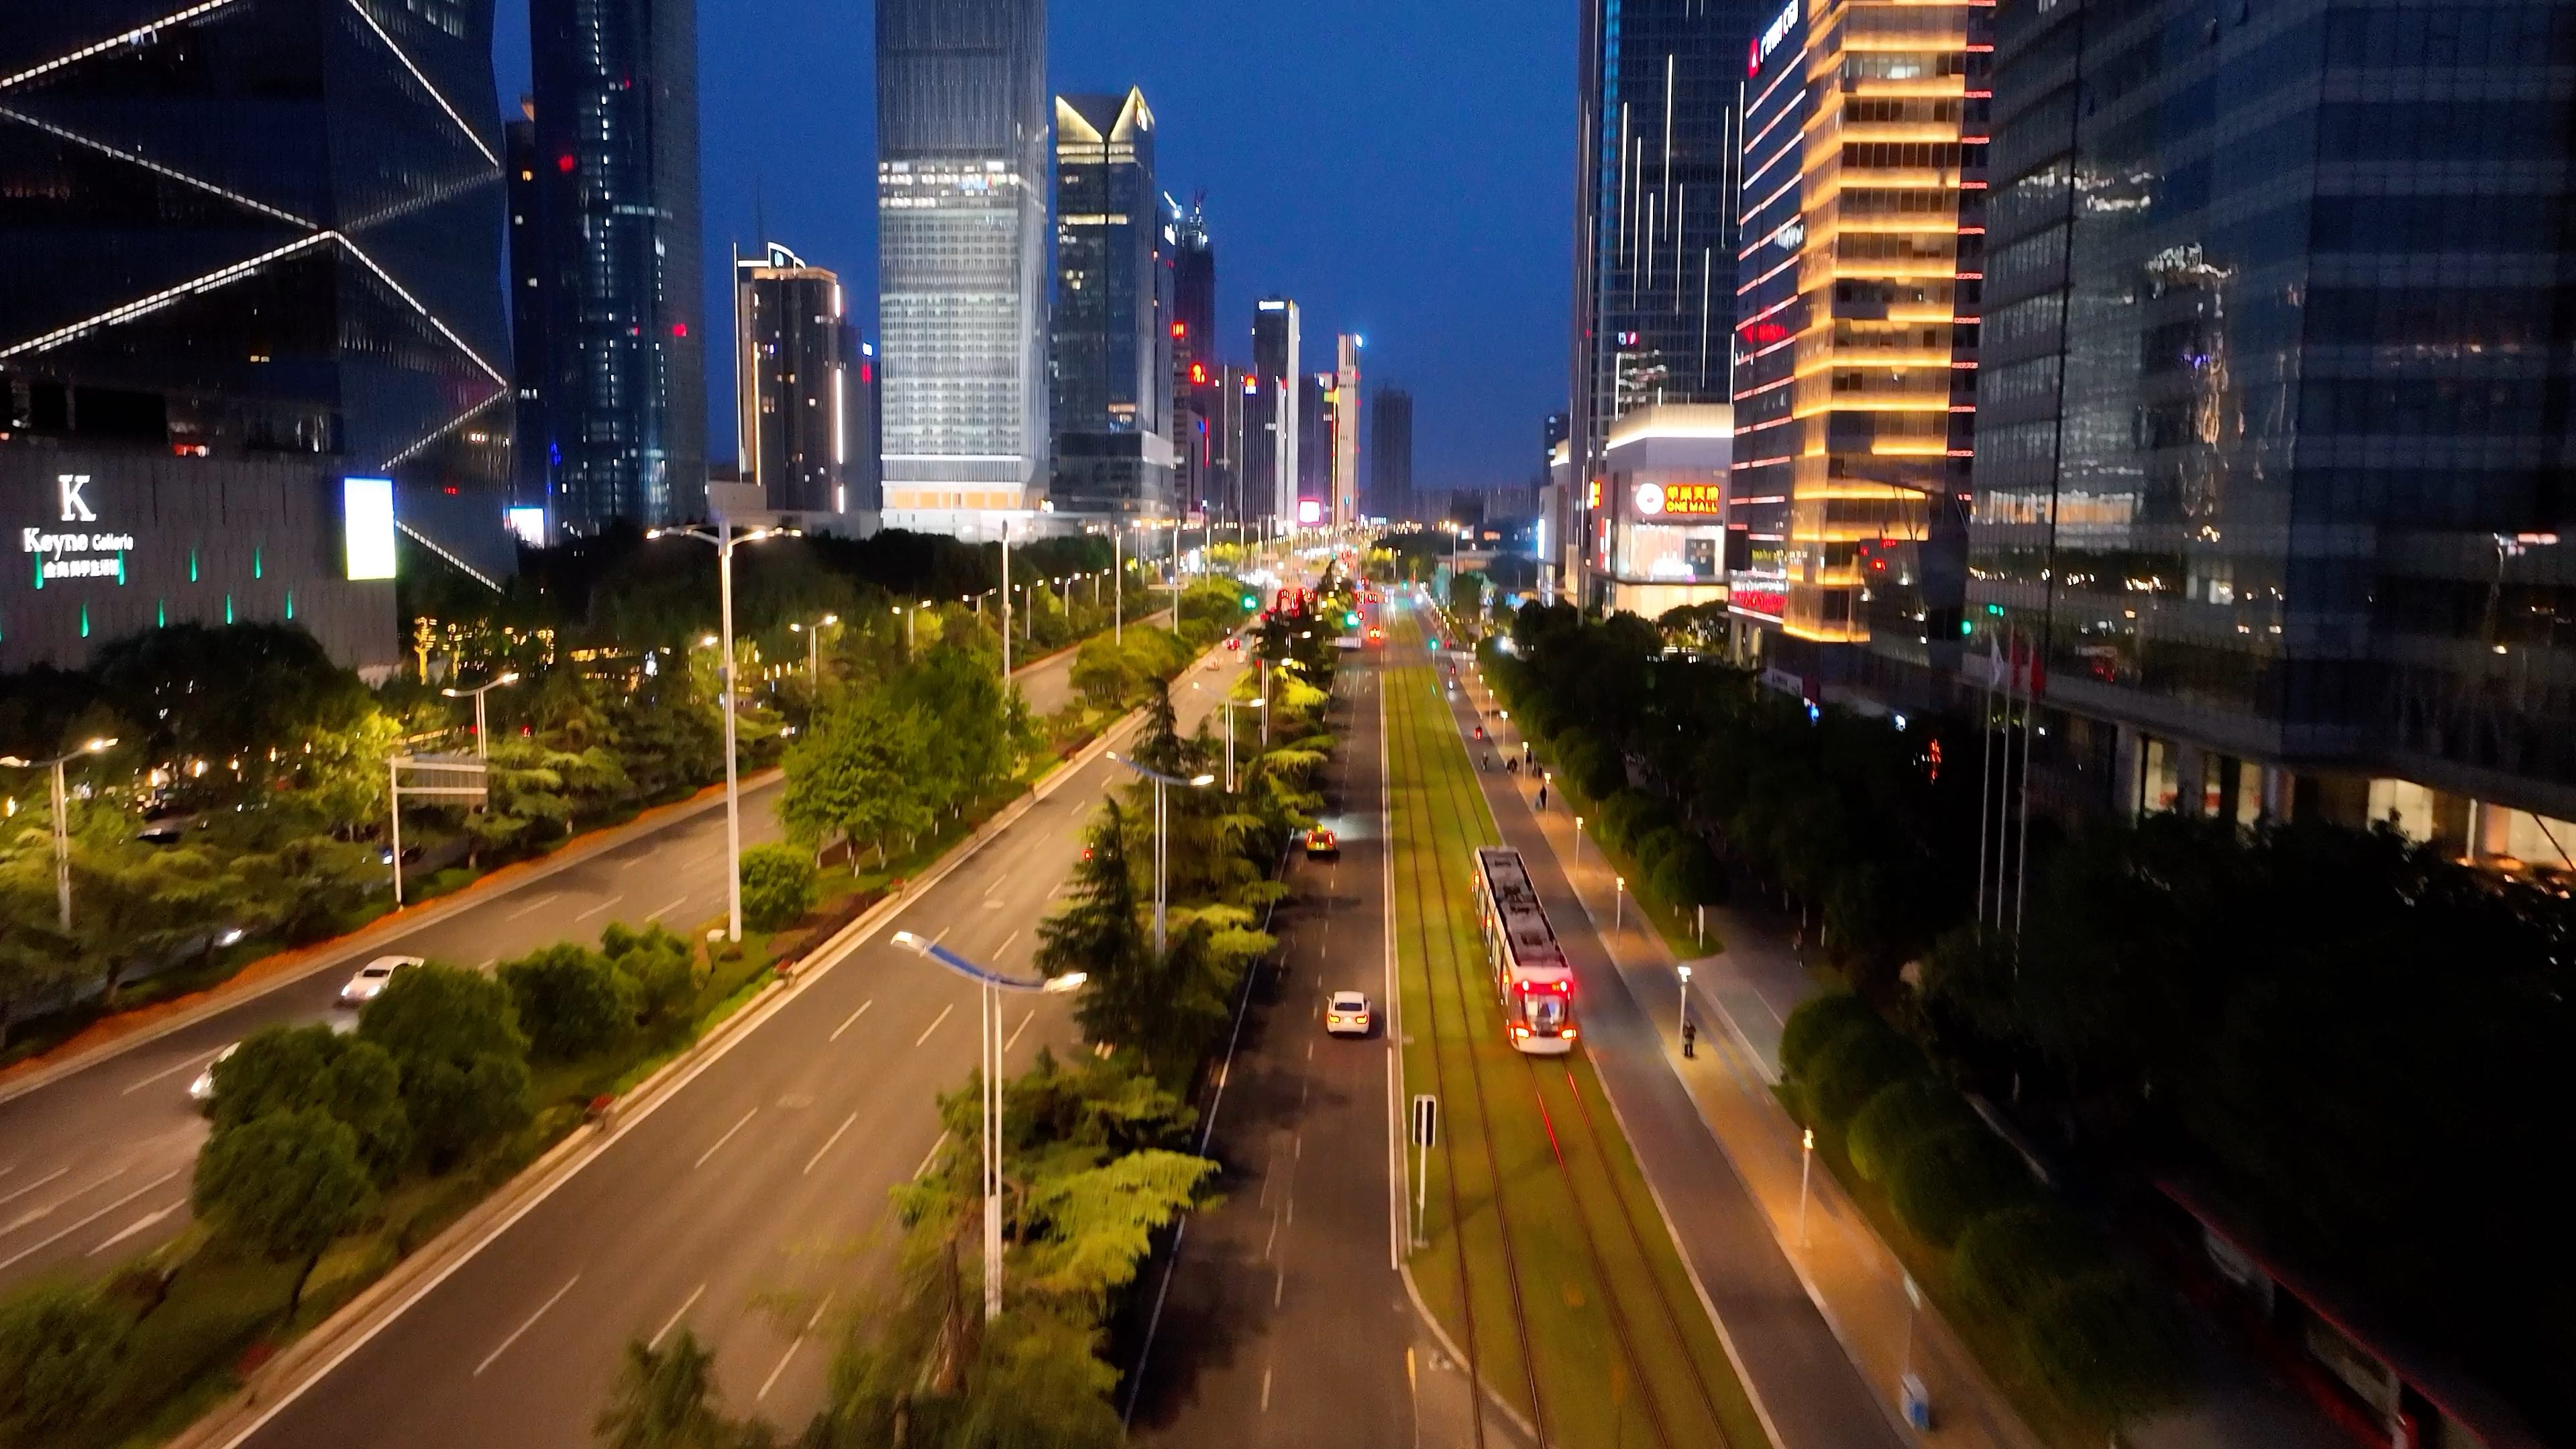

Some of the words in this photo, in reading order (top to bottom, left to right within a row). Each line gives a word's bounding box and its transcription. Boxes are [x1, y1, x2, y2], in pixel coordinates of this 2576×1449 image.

[58, 474, 97, 521] K
[1666, 501, 1688, 513] ONE
[1689, 501, 1718, 513] MALL
[23, 527, 89, 561] Keyne
